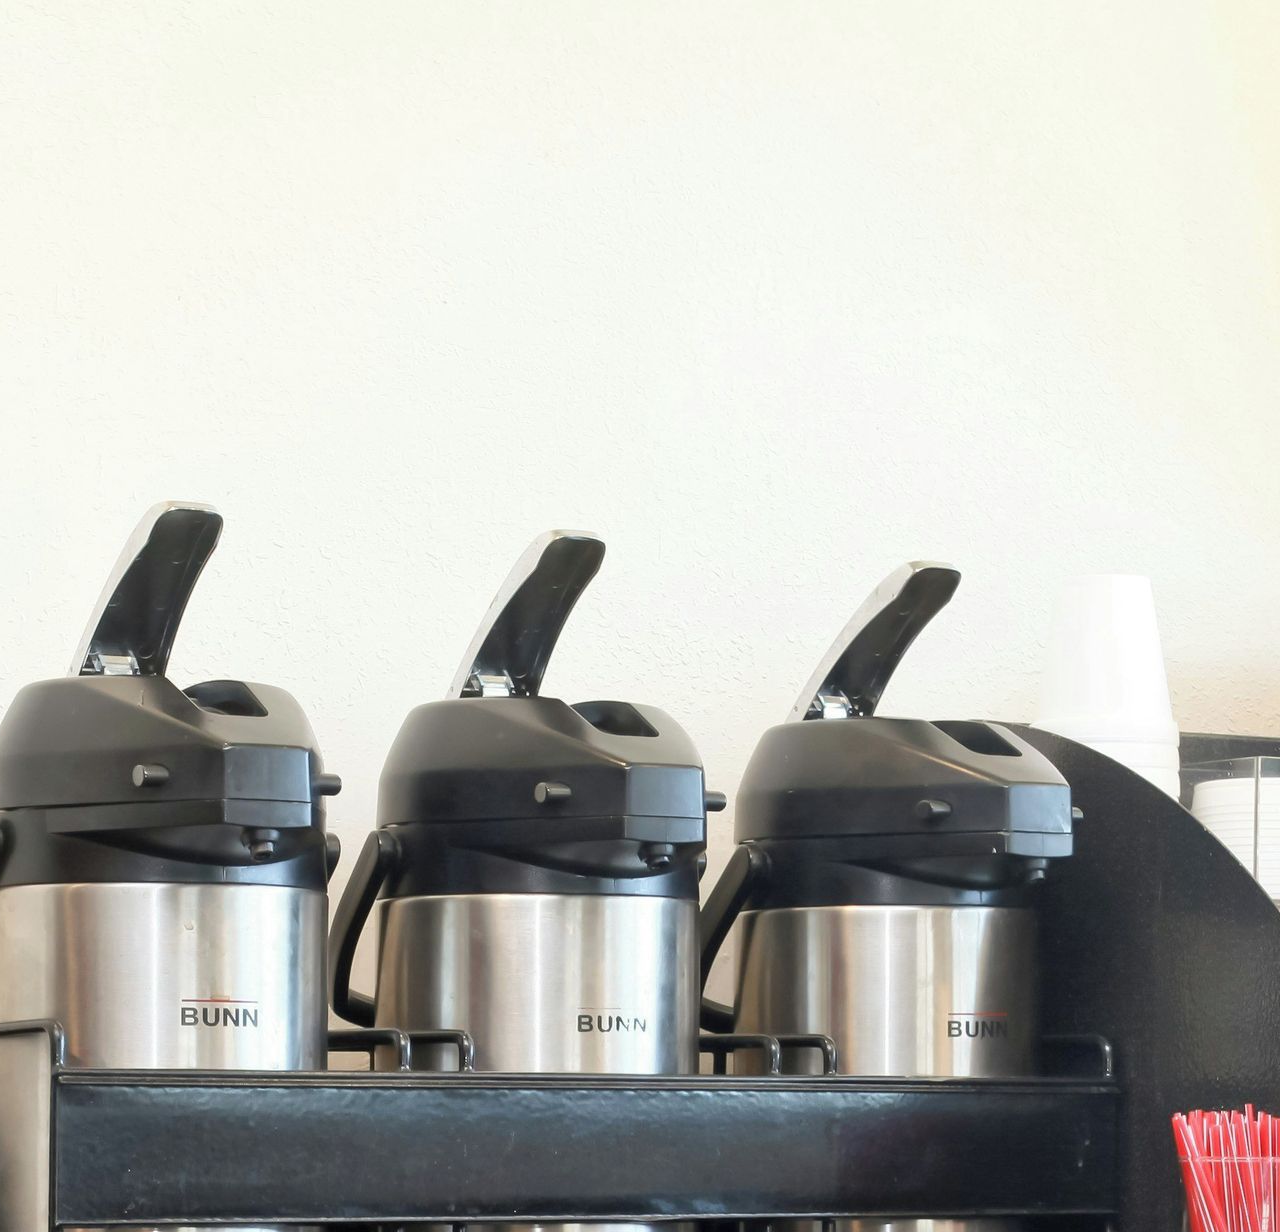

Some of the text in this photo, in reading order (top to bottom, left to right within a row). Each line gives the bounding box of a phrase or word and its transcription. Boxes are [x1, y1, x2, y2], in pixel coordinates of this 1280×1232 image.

[180, 1007, 258, 1027] BUNN
[577, 1014, 647, 1032] BUNN
[947, 1020, 1009, 1038] BUNN
